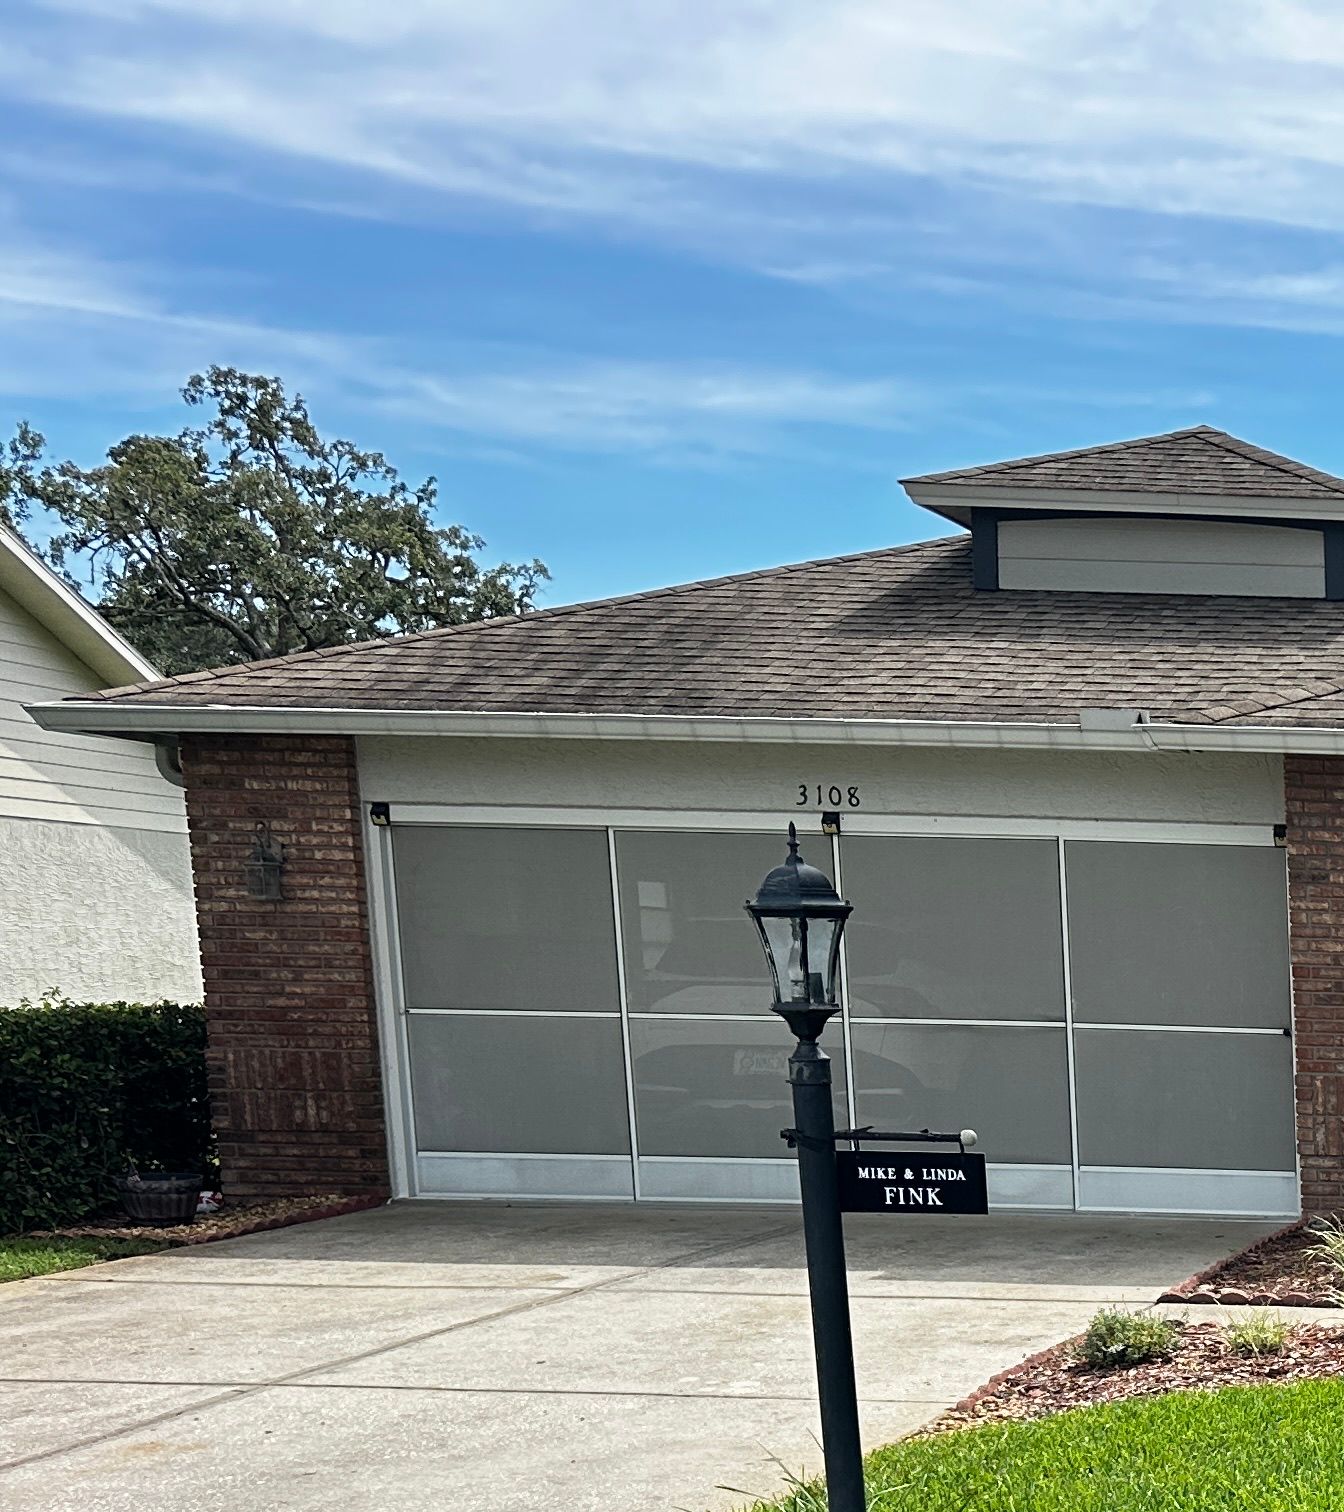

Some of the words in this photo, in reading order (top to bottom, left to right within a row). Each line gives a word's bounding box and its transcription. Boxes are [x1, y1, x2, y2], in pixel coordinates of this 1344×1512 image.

[796, 784, 860, 807] 3108
[857, 1166, 897, 1179] MIKE
[903, 1168, 915, 1180] &
[922, 1168, 966, 1181] LINDA
[884, 1186, 944, 1206] FINK
